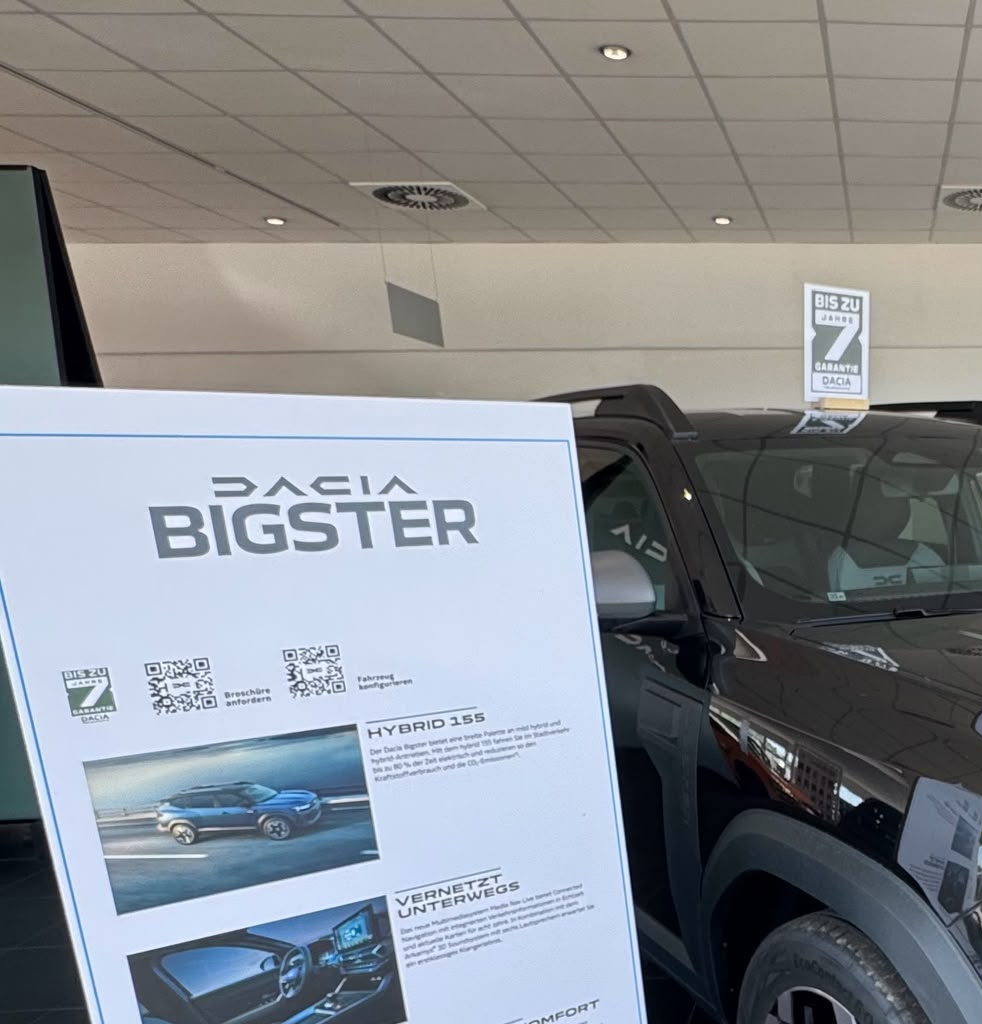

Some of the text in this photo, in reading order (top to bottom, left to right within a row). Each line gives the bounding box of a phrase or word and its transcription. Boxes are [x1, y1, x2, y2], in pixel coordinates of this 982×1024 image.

[814, 293, 860, 312] BIS ZU
[814, 361, 859, 374] GARANTIE
[821, 375, 852, 387] DACIA
[211, 475, 418, 498] DACIA
[147, 499, 479, 559] BIGSTER
[64, 668, 107, 680] BIS ZU
[357, 673, 395, 684] Fahrzeug
[358, 678, 413, 690] konfigurieren
[224, 687, 271, 699] Broschüre
[225, 695, 272, 707] anfordern
[81, 714, 110, 722] DACIA
[367, 712, 486, 739] HYBRID 155
[395, 873, 503, 907] VERNETZT
[397, 881, 520, 919] UNTERWEGS
